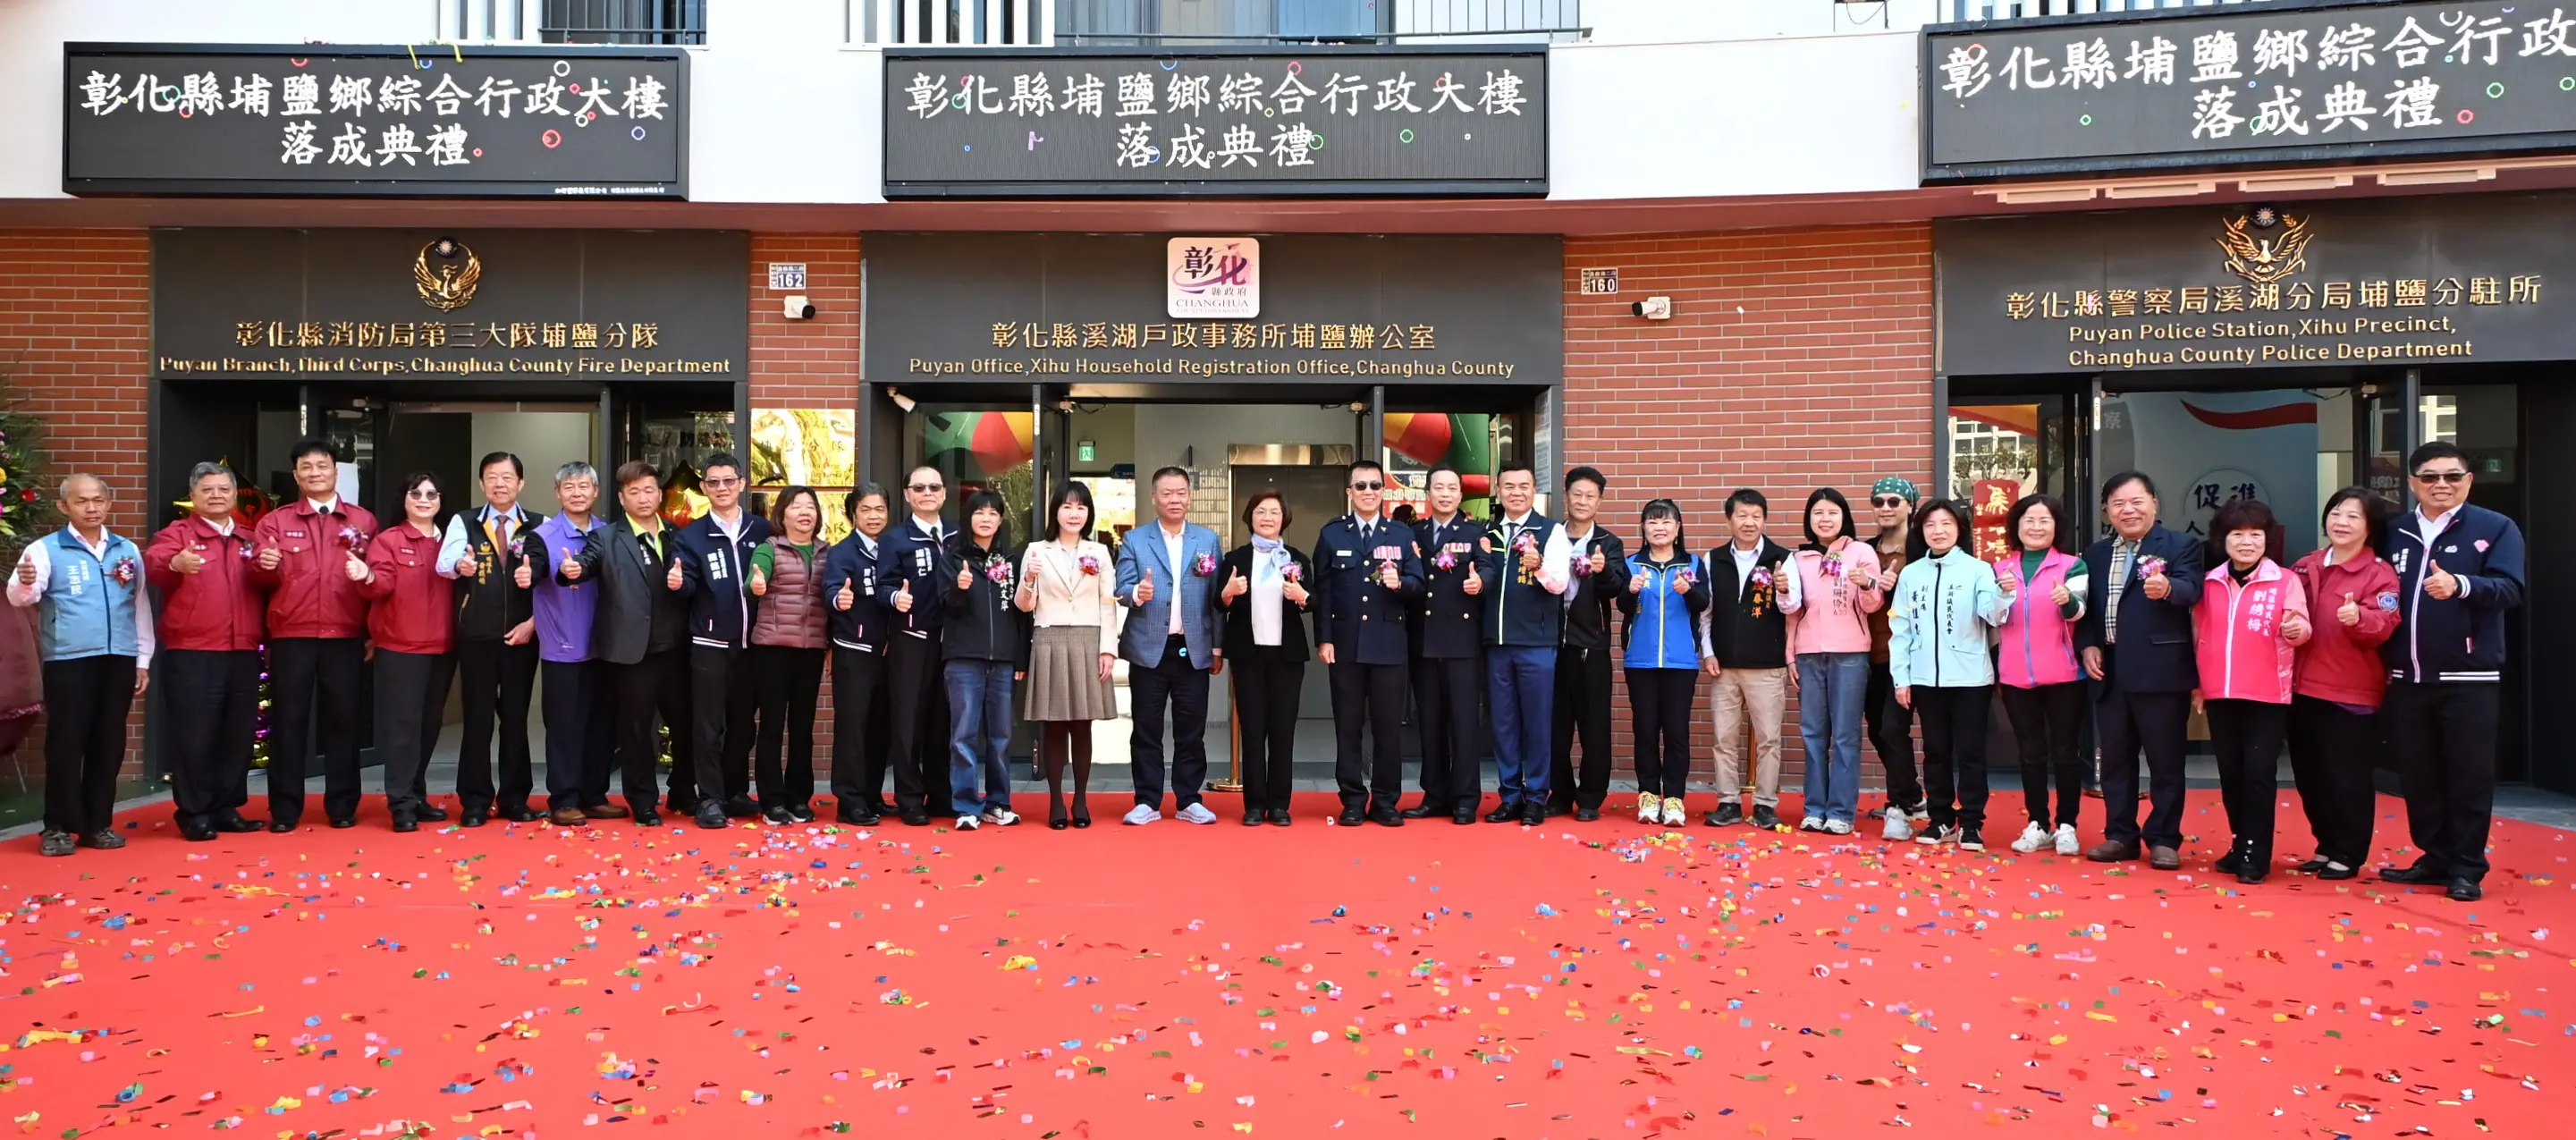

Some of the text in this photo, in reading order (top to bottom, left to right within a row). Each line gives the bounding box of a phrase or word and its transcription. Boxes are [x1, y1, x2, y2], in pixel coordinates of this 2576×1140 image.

[78, 70, 669, 120] 彰化縣埔鹽鄉綜合行政大樓
[904, 69, 1528, 118] 彰化縣埔鹽鄉綜合行政大樓
[2191, 80, 2444, 139] 落成典禮
[280, 122, 470, 167] 落成典禮
[1116, 122, 1315, 168] 落成典禮
[779, 274, 803, 287] 162
[1590, 278, 1616, 292] 160
[1176, 299, 1249, 308] CHANGHUA
[2006, 275, 2542, 320] 彰化縣警察局溪湖分局埔鹽分駐所
[235, 320, 659, 349] 彰化縣消防局第三大隊埔鹽分隊
[992, 321, 1436, 349] 彰化縣溪湖戶政事務所埔鹽辦公室
[2069, 326, 2133, 344] Puyan
[2140, 323, 2207, 341] Police
[2354, 316, 2457, 335] Precinct,
[160, 357, 218, 375] Puyan
[509, 358, 573, 376] County
[578, 358, 615, 373] Fire
[621, 358, 731, 376] Department
[909, 358, 965, 377] Puyan
[1076, 359, 1172, 374] Household
[1178, 359, 1291, 377] Registration
[1451, 360, 1515, 379] County
[2069, 341, 2473, 368] Changhua County Police Department
